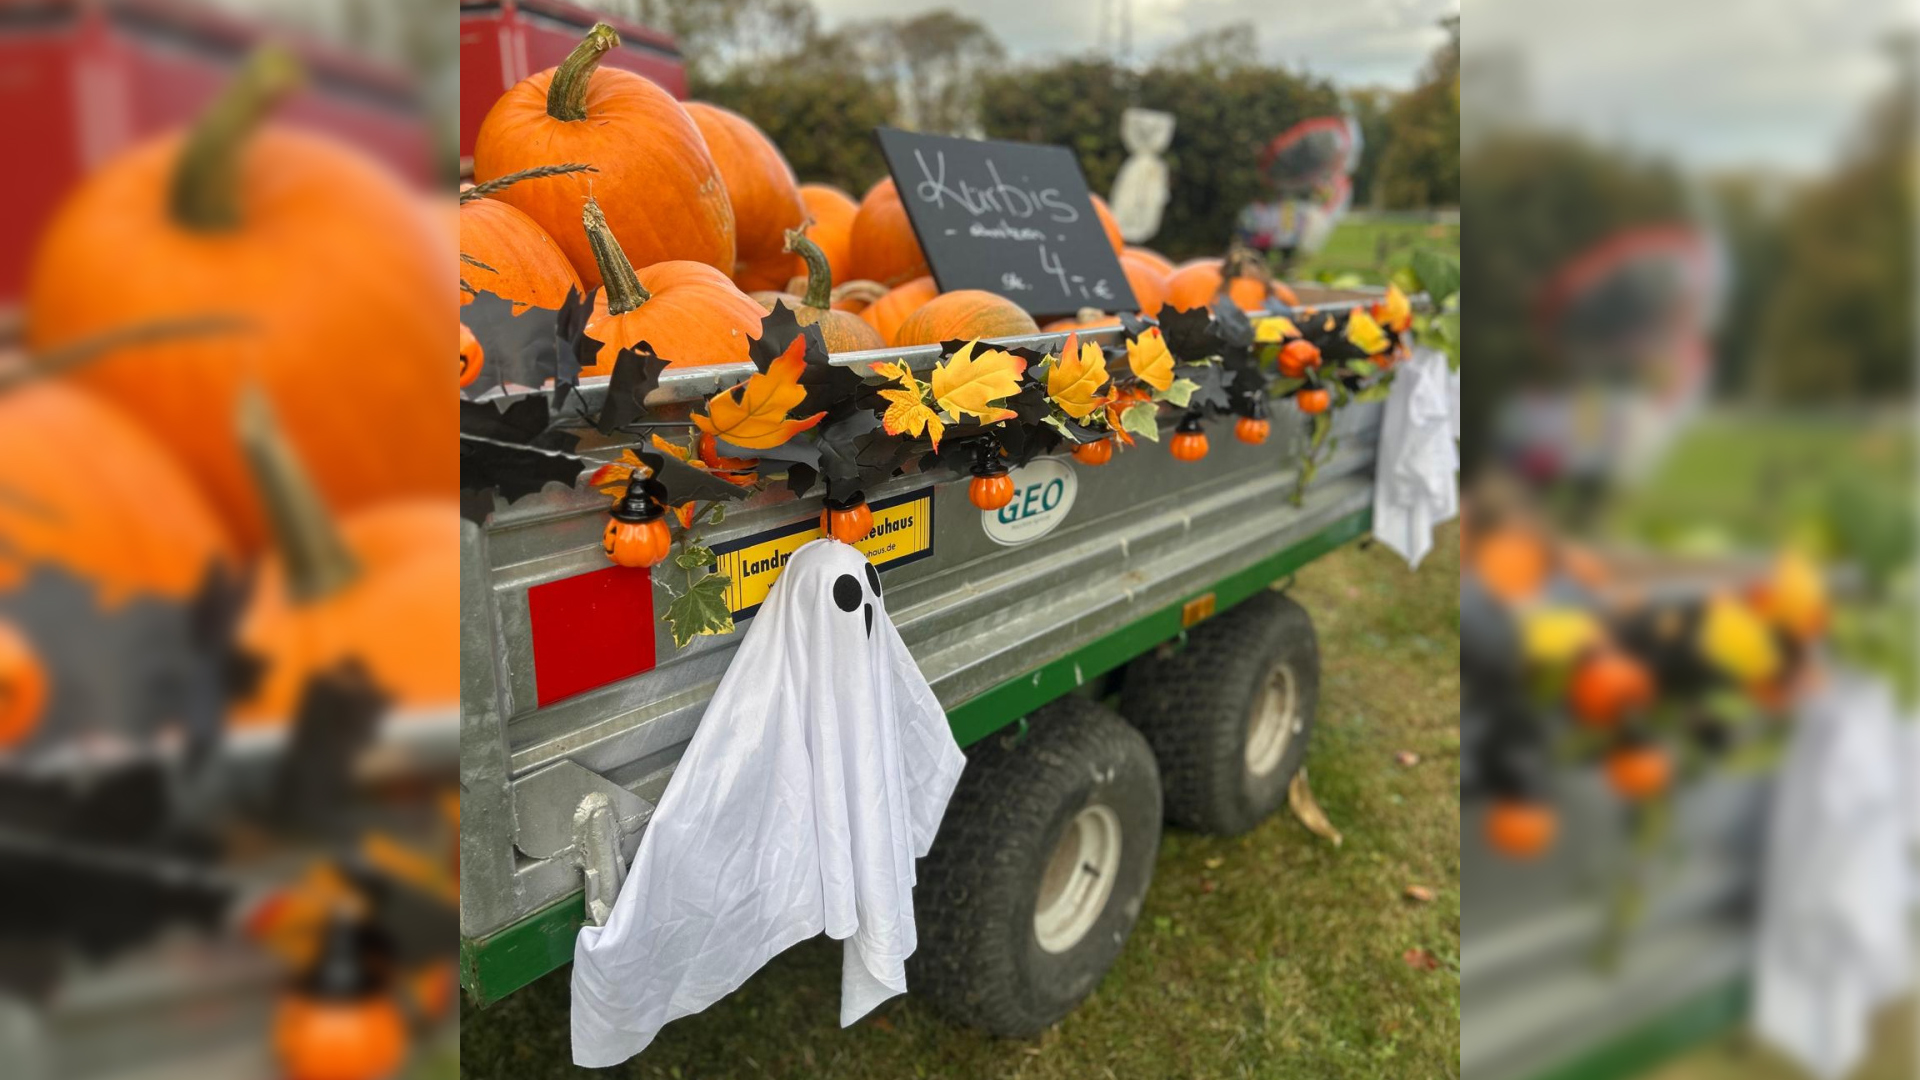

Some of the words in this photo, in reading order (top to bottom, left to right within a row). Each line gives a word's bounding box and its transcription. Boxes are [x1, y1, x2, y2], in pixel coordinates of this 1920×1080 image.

[998, 478, 1064, 524] GEO
[742, 549, 793, 578] Landm
[860, 516, 914, 542] euhaus
